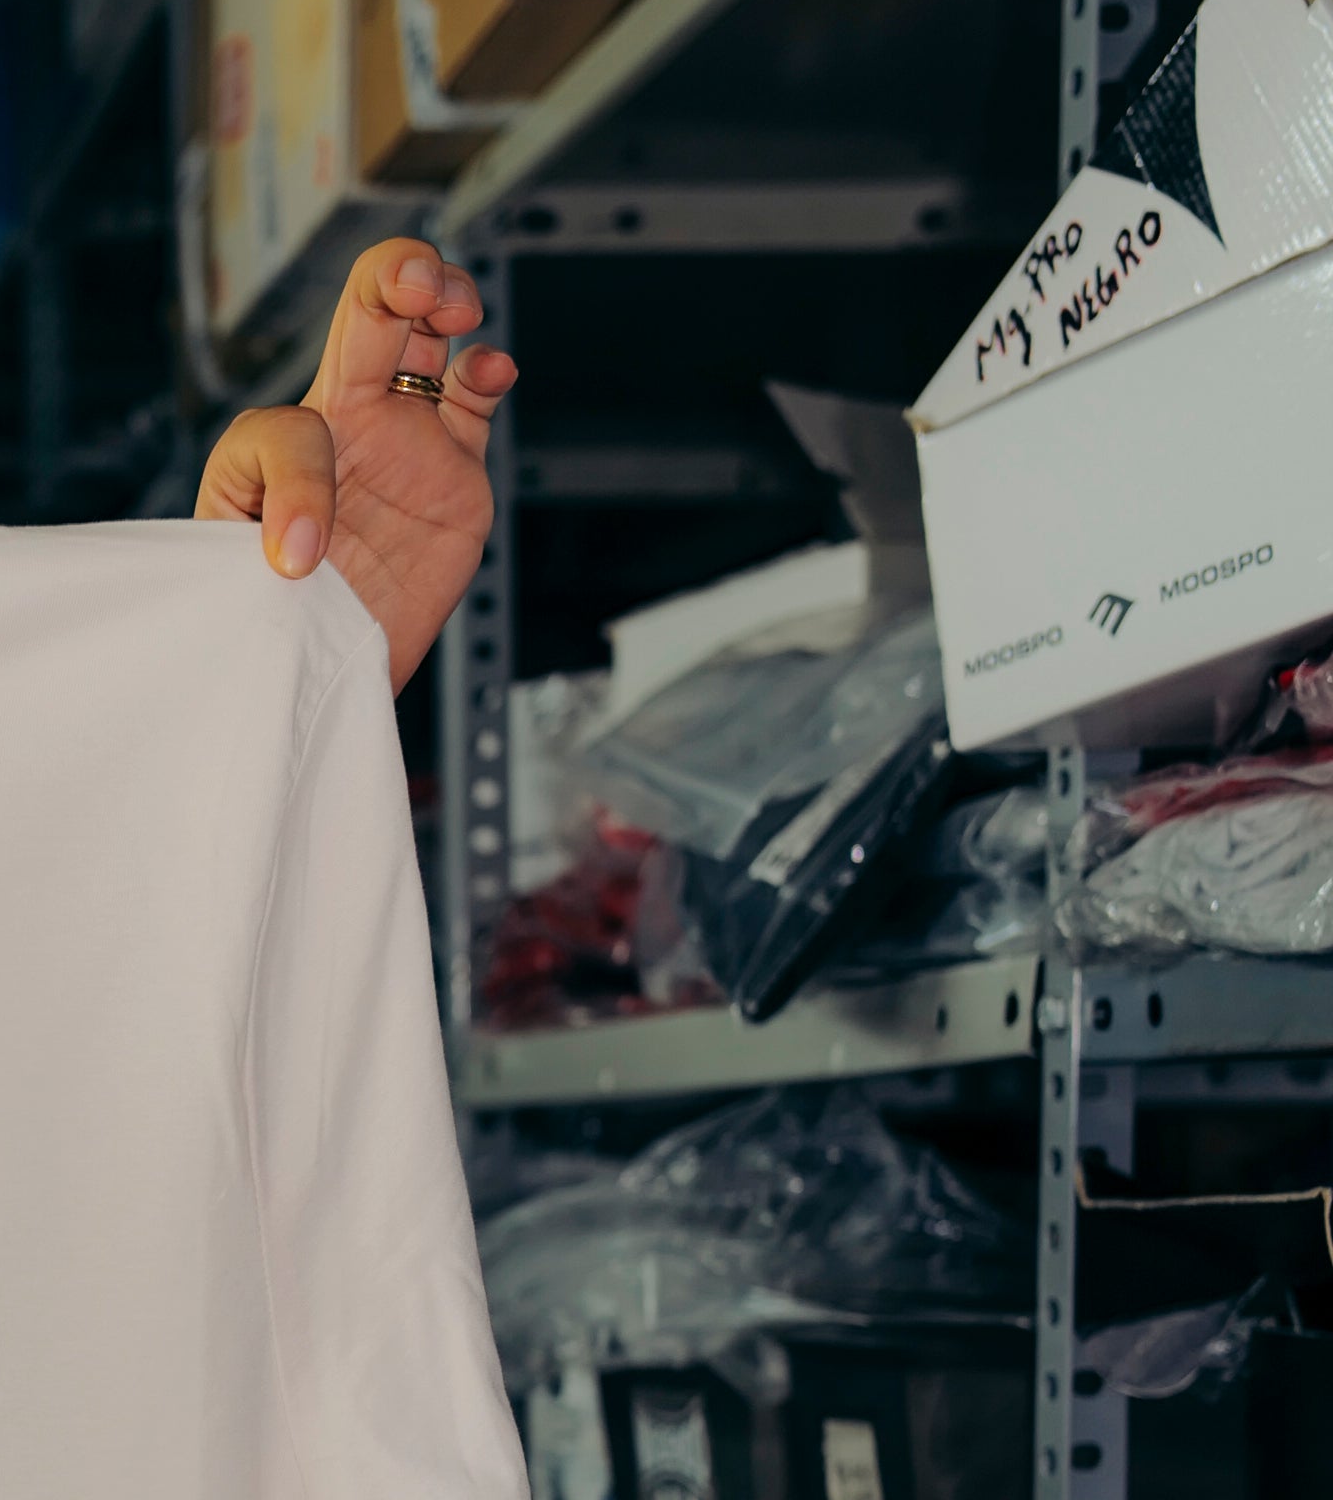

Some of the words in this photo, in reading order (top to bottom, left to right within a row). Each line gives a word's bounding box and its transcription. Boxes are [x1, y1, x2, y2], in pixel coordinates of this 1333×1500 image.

[1059, 210, 1163, 350] NEGRO
[1158, 542, 1275, 603] MOOSPO
[963, 624, 1064, 679] MOOSPO
